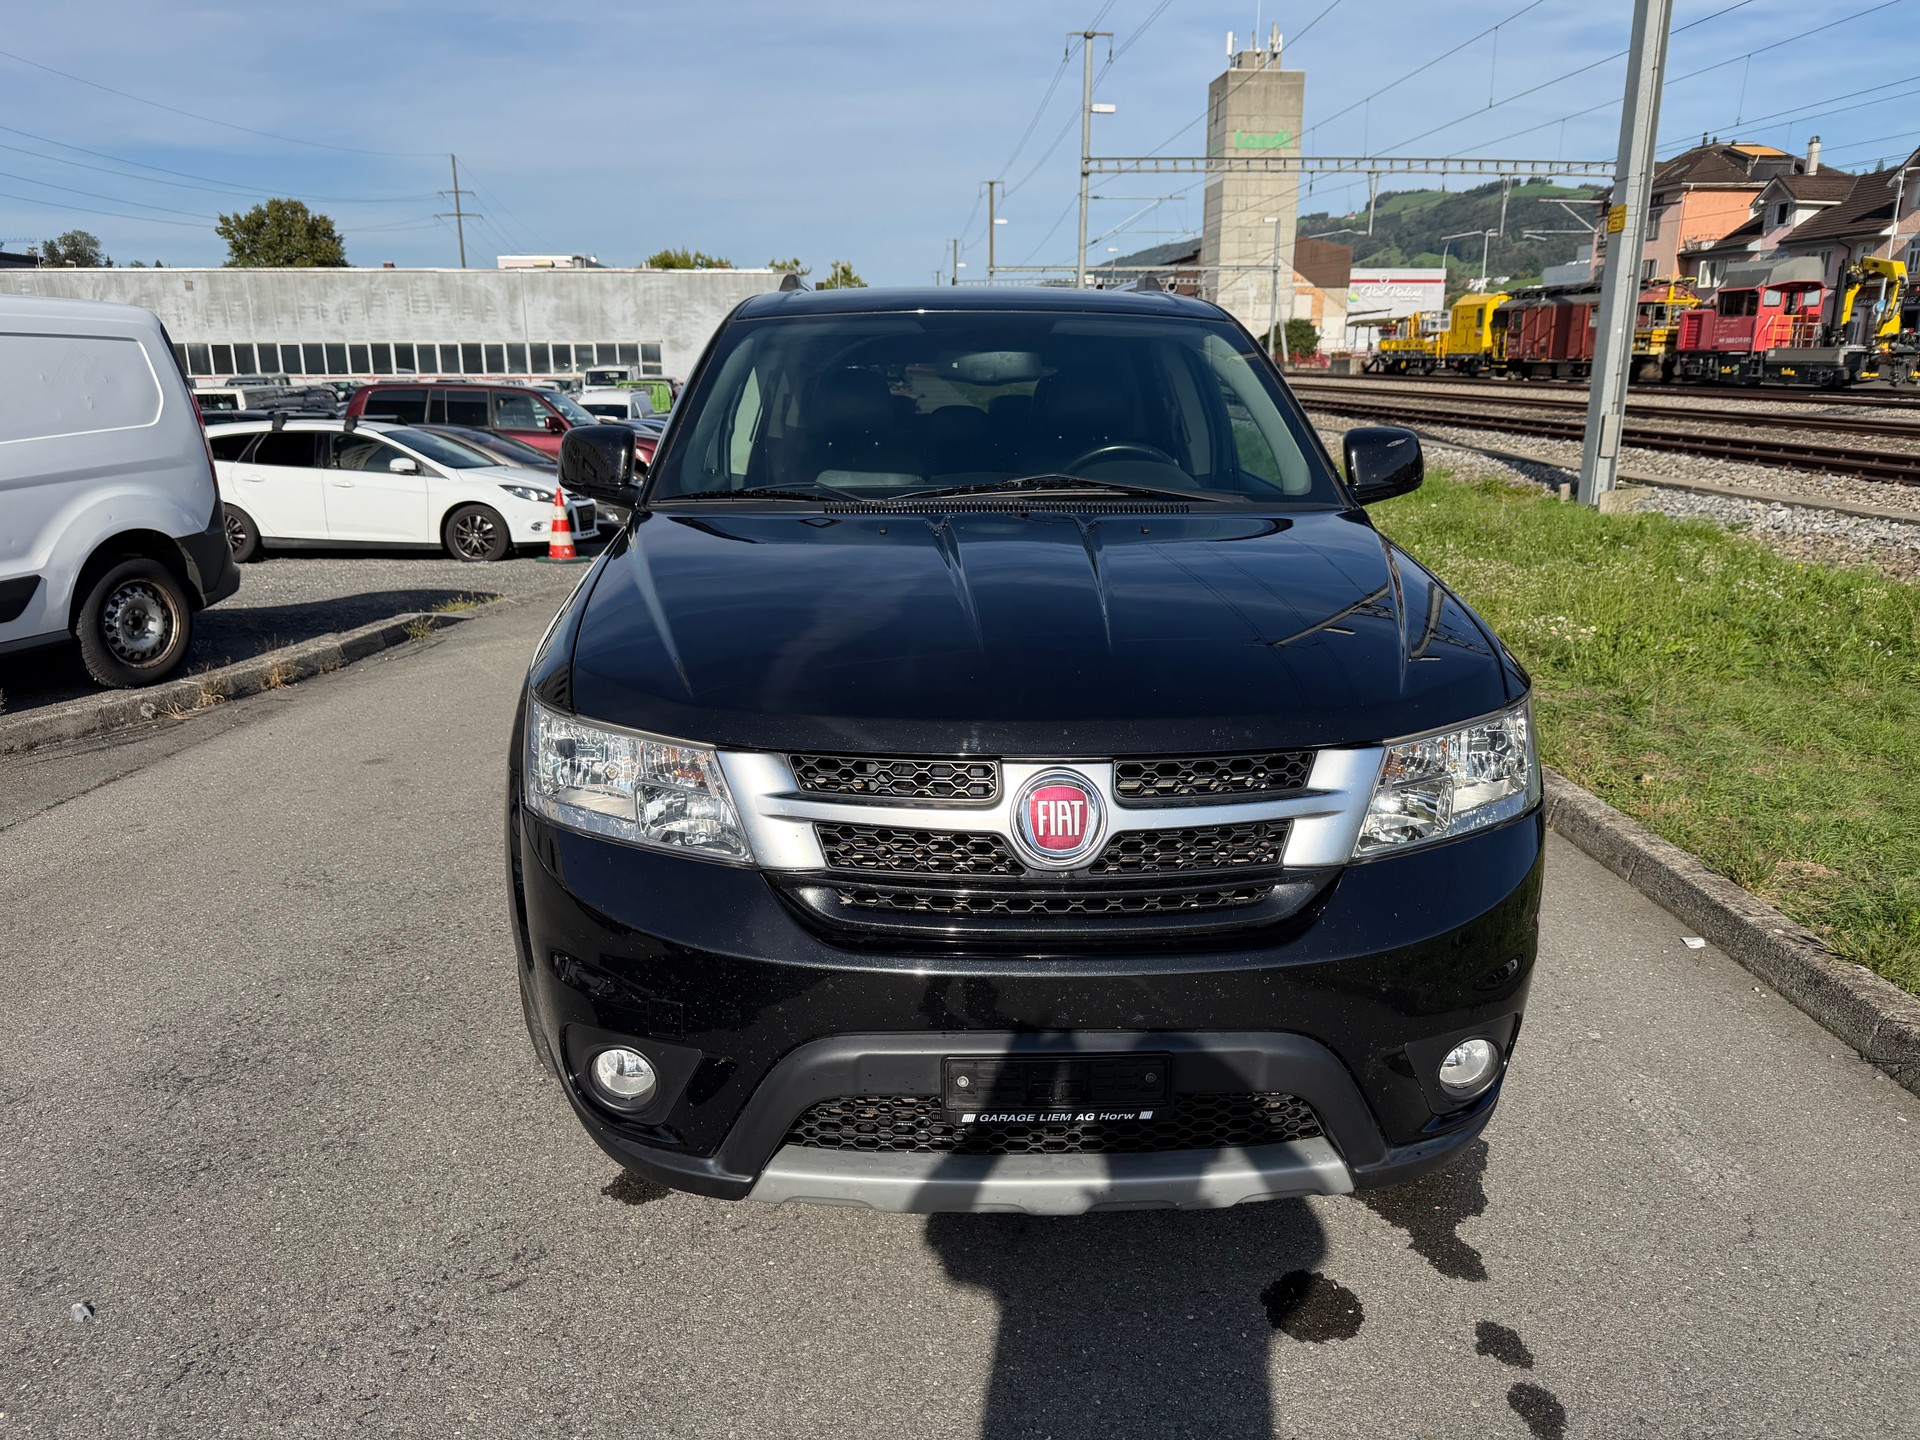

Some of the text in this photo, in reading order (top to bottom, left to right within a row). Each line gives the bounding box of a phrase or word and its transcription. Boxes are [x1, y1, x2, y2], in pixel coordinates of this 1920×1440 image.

[1037, 800, 1084, 836] FIAT
[979, 1112, 1135, 1123] GARAGE LIEM AG Horw
